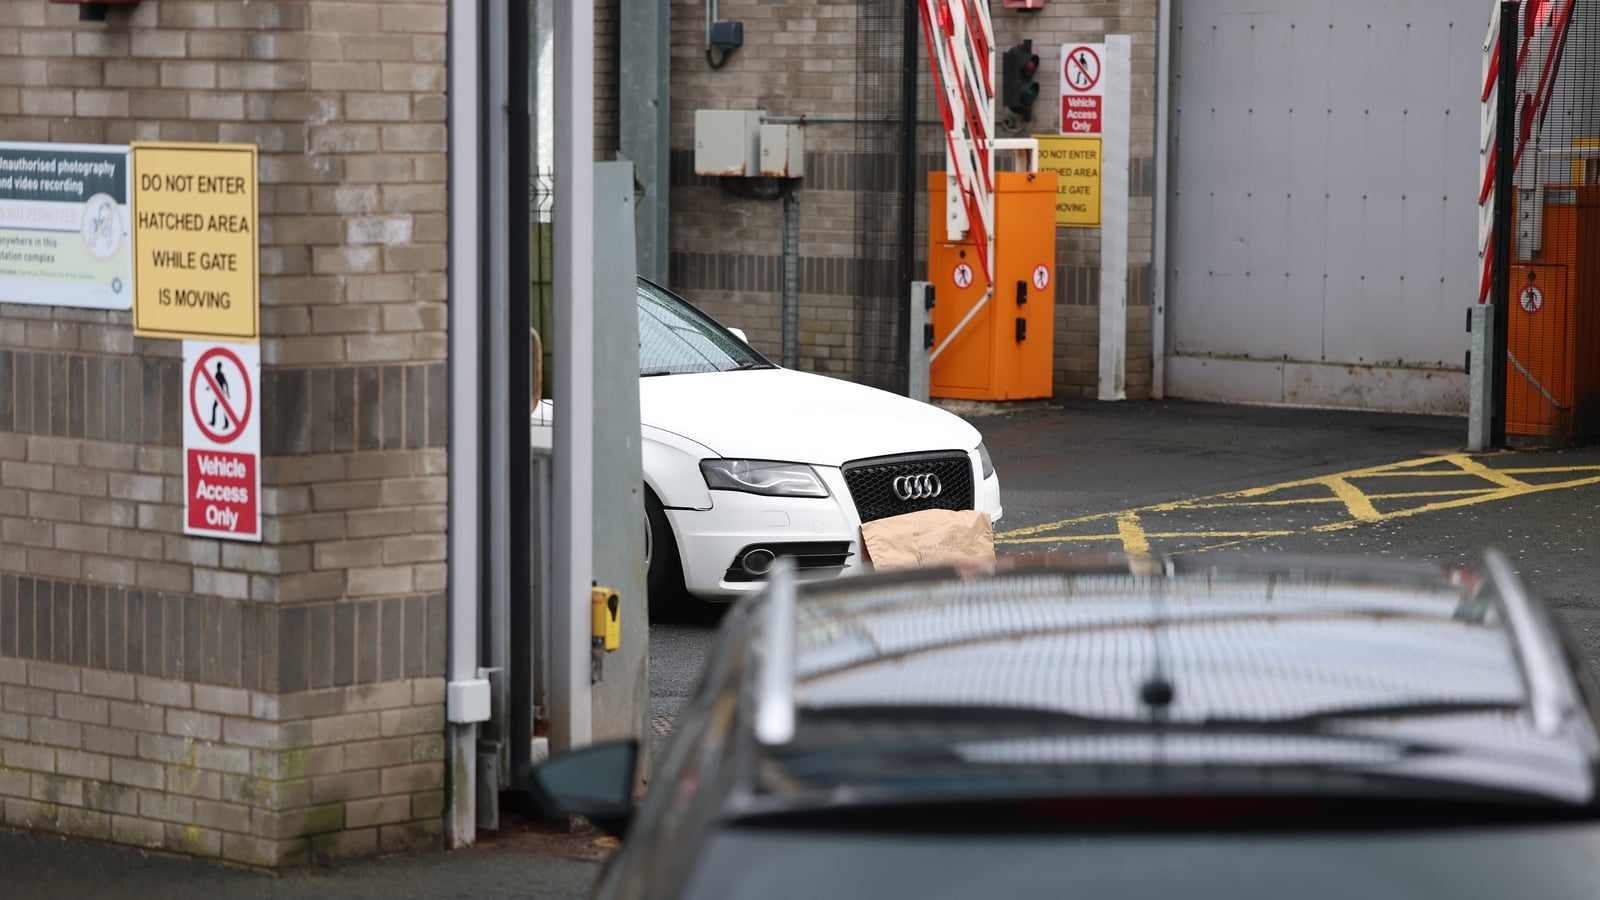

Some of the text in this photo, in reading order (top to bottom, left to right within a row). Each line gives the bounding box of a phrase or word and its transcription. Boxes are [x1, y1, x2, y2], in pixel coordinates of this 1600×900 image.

[1067, 97, 1097, 108] Vehicle
[1066, 109, 1098, 120] Access
[1071, 120, 1092, 132] Only
[1050, 149, 1067, 159] NOT
[1069, 150, 1097, 160] ENTER
[57, 158, 116, 178] photography
[1074, 168, 1098, 178] AREA
[13, 175, 39, 191] video
[40, 177, 84, 196] recording
[141, 173, 246, 194] DO NOT ENTER
[1069, 185, 1091, 195] GATE
[139, 211, 249, 234] HATCHED AREA
[34, 236, 41, 247] in
[43, 236, 57, 249] this
[24, 252, 55, 264] complex
[152, 250, 238, 272] WHILE GATE
[159, 288, 231, 310] IS MOVING
[197, 454, 247, 479] Vehicle
[196, 479, 249, 504] Access
[205, 504, 239, 532] Only
